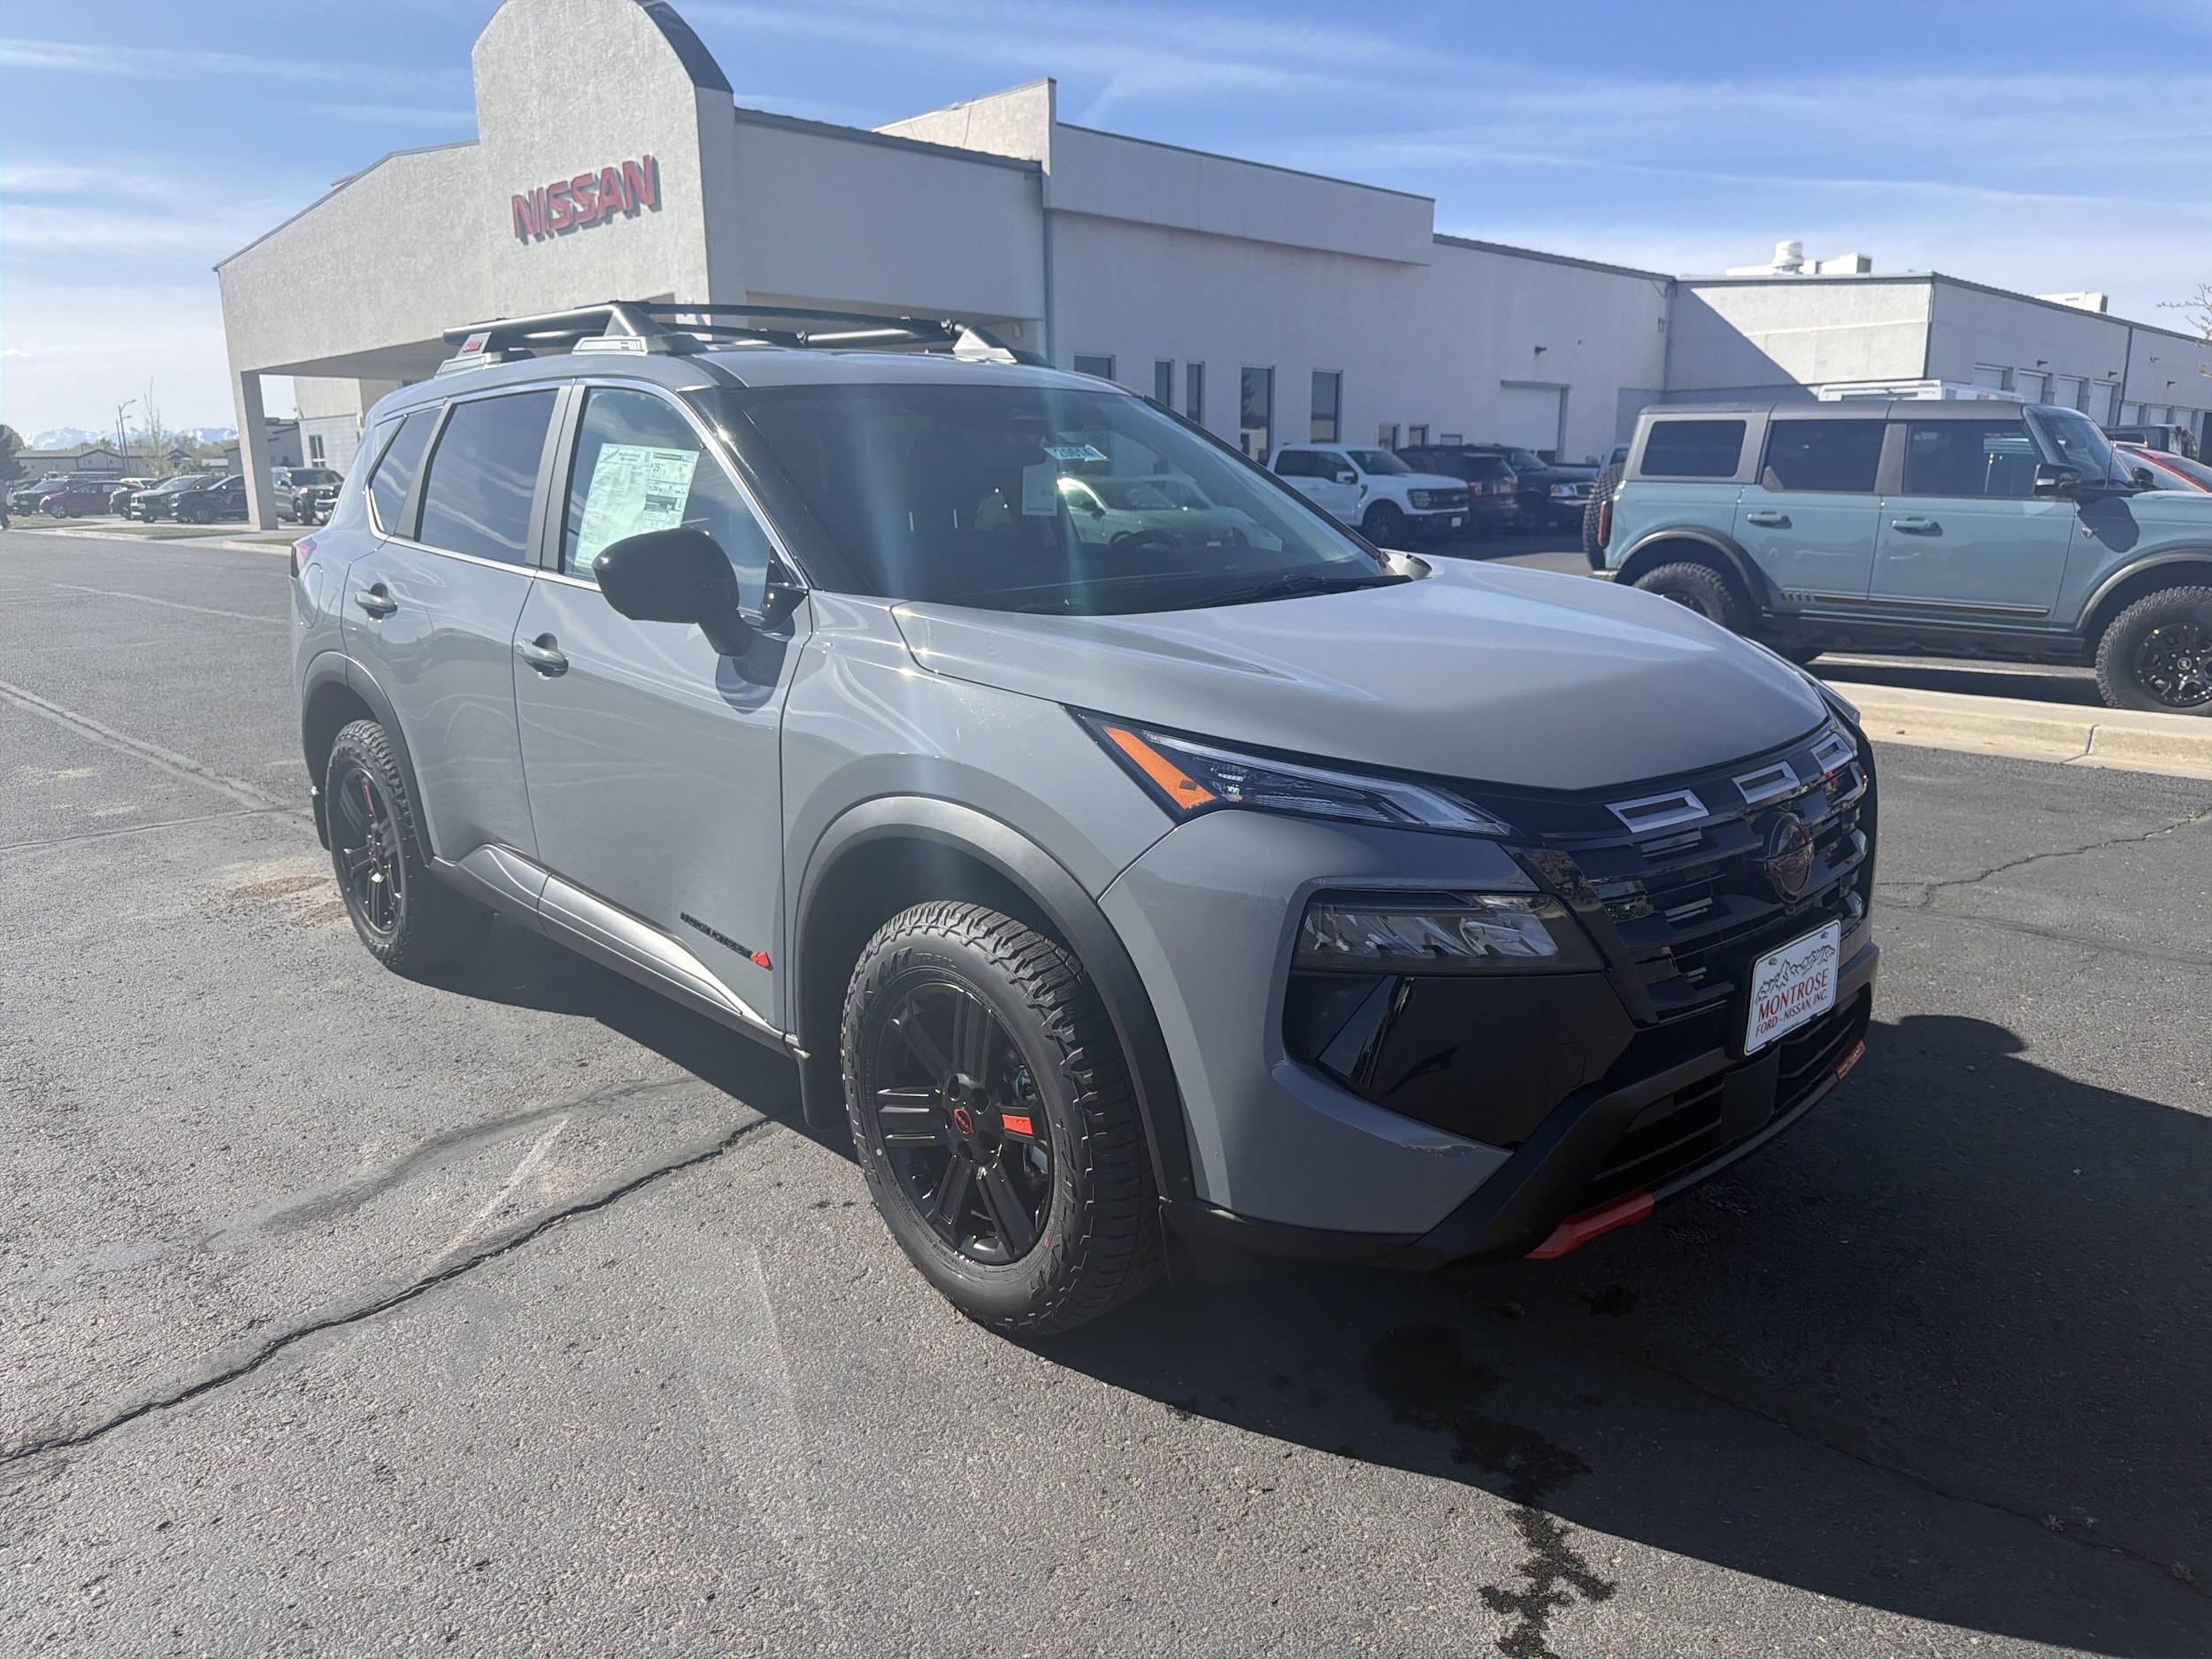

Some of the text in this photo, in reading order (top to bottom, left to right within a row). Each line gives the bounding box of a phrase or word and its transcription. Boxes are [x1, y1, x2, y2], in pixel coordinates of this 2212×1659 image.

[511, 155, 657, 240] NISSAN
[1755, 1016, 1778, 1038] FORD
[1813, 988, 1827, 1005] INC.
[1757, 968, 1829, 1023] MONTROSE
